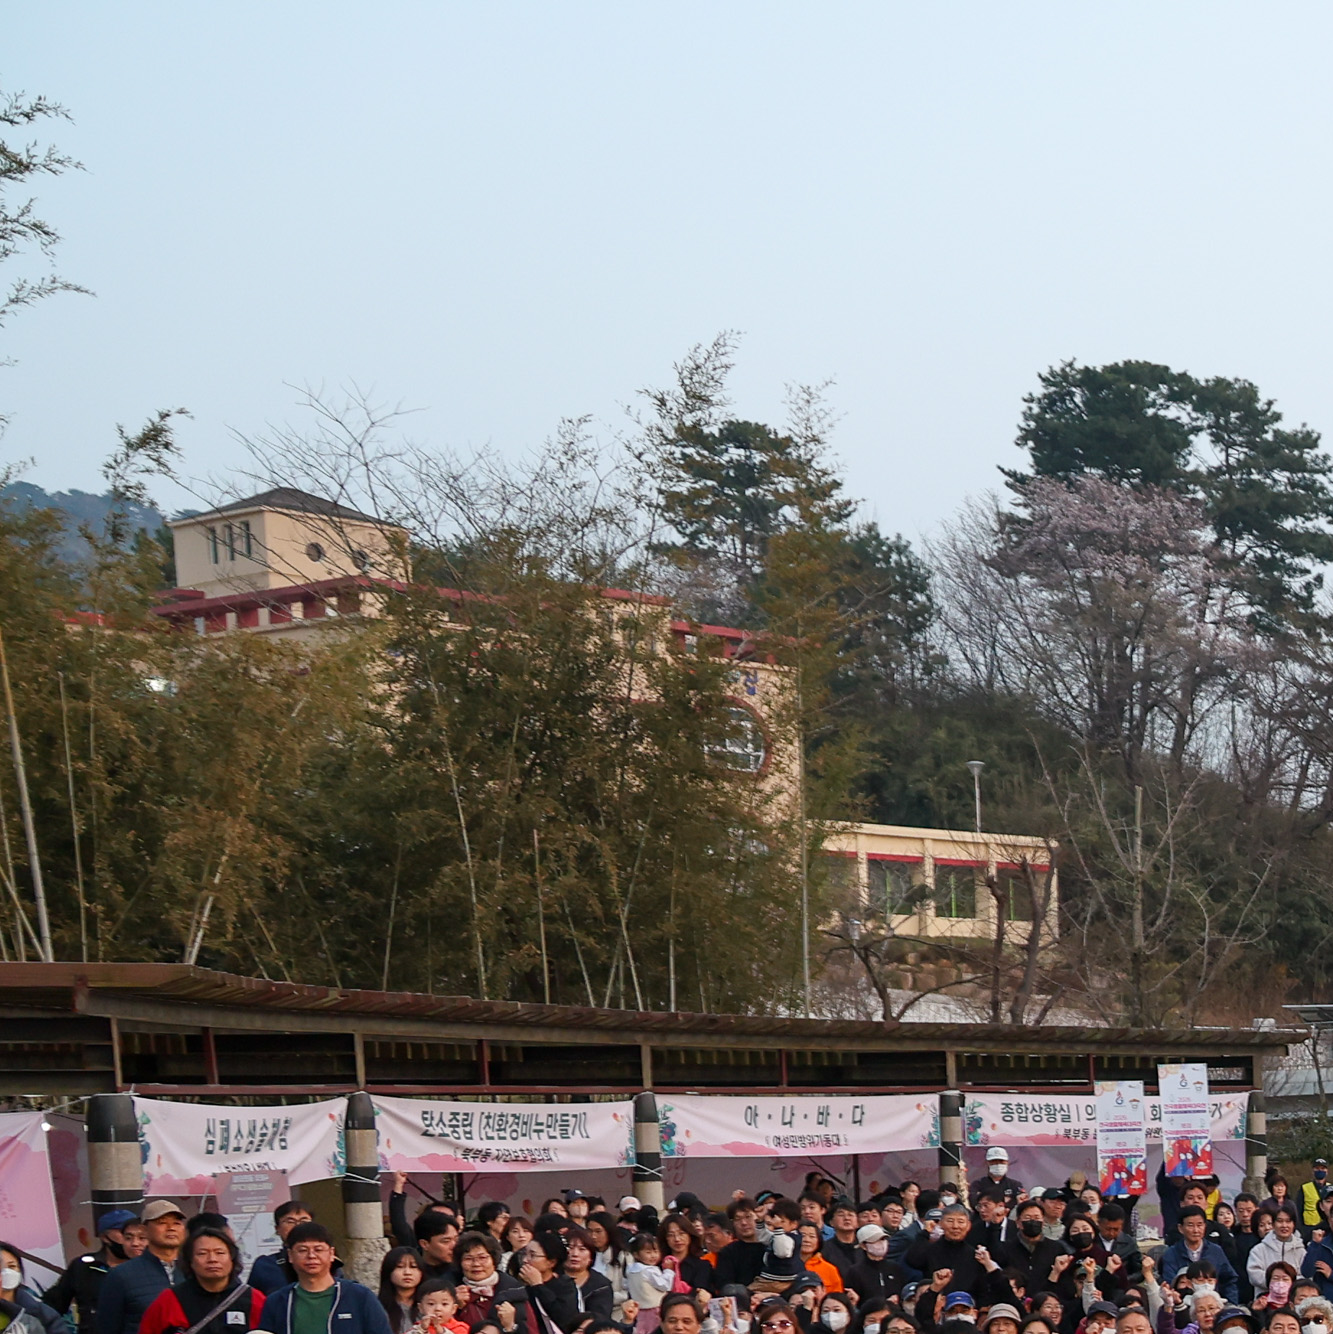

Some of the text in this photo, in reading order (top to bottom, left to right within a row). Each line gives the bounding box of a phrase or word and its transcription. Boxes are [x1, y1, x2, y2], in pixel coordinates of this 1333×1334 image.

[1000, 1102, 1072, 1123] 종합상황실
[420, 1110, 474, 1139] 탄소중립
[772, 1134, 842, 1149] 여성민방위기동대
[1063, 1128, 1090, 1140] 북부동
[461, 1147, 553, 1164] 북부동 자연보호협의회
